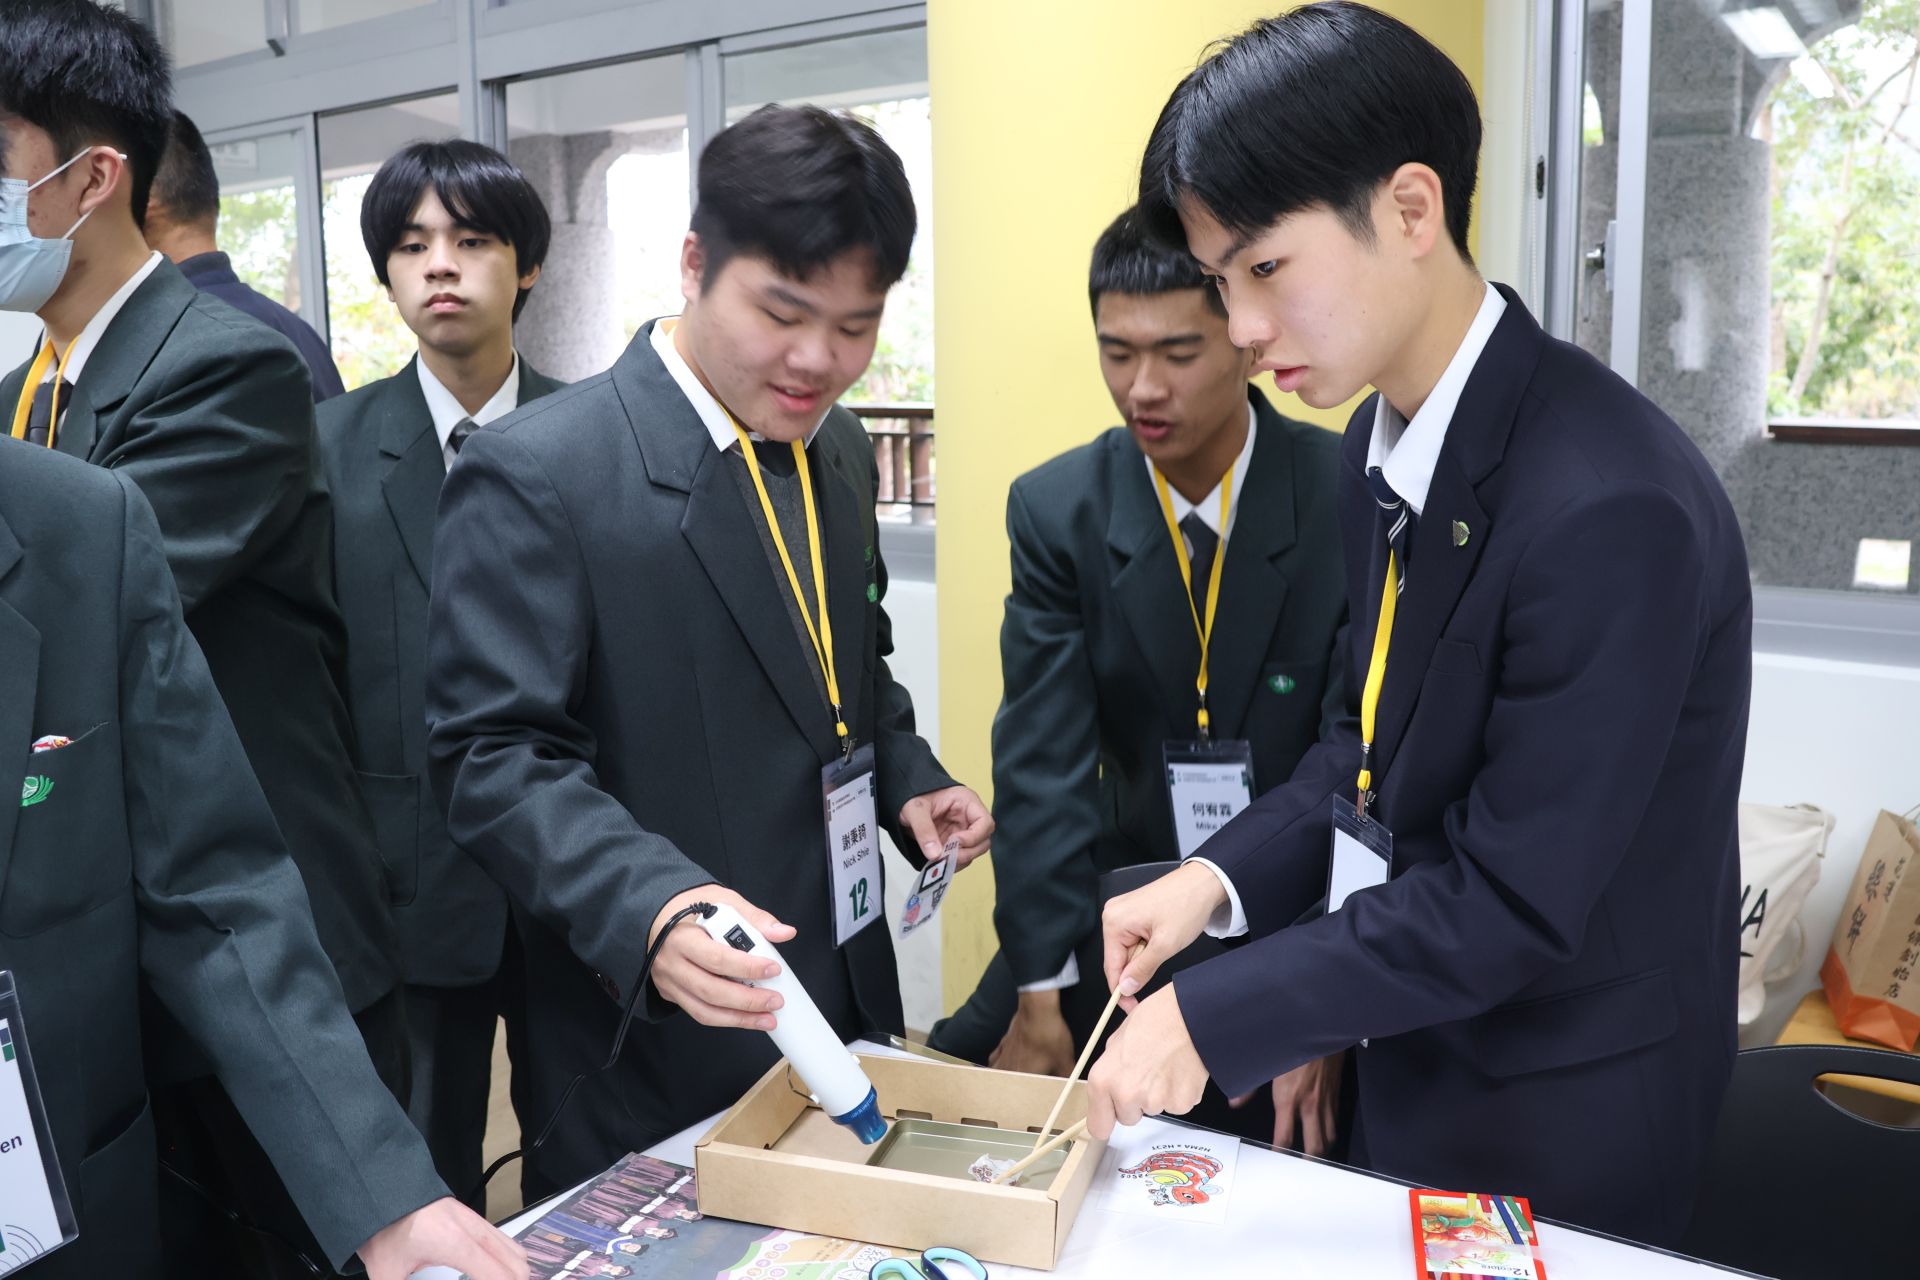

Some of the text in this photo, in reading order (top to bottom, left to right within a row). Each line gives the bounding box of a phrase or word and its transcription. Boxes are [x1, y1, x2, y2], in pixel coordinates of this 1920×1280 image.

[1195, 821, 1218, 831] Mike
[843, 855, 857, 870] Nick
[849, 877, 869, 922] 12
